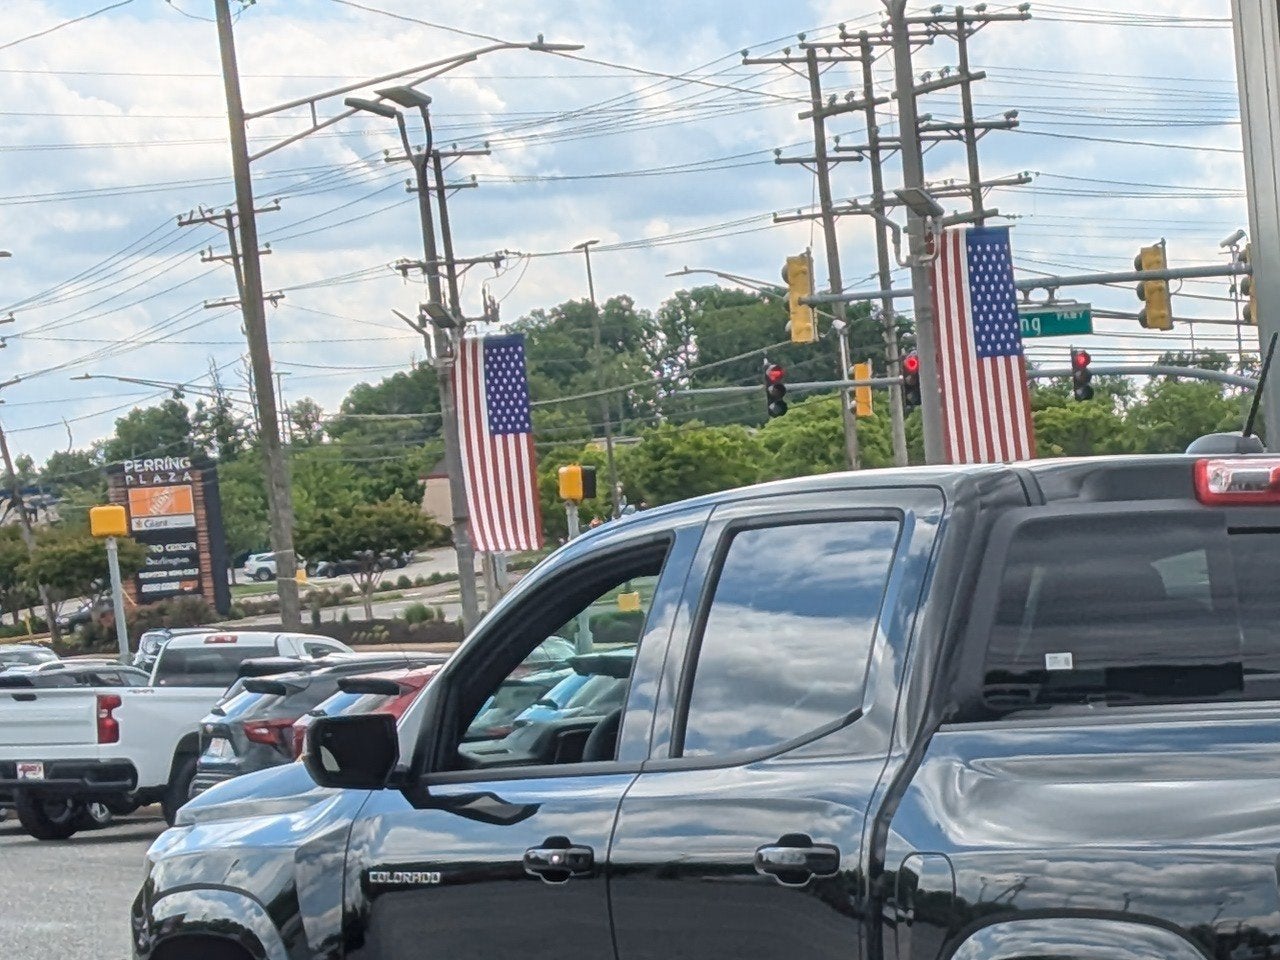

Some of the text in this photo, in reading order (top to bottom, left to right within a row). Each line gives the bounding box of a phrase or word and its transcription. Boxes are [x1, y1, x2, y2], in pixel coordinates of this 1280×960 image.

[124, 456, 191, 473] PERRING
[125, 472, 193, 485] PLAZA
[369, 871, 441, 884] COLORADO
